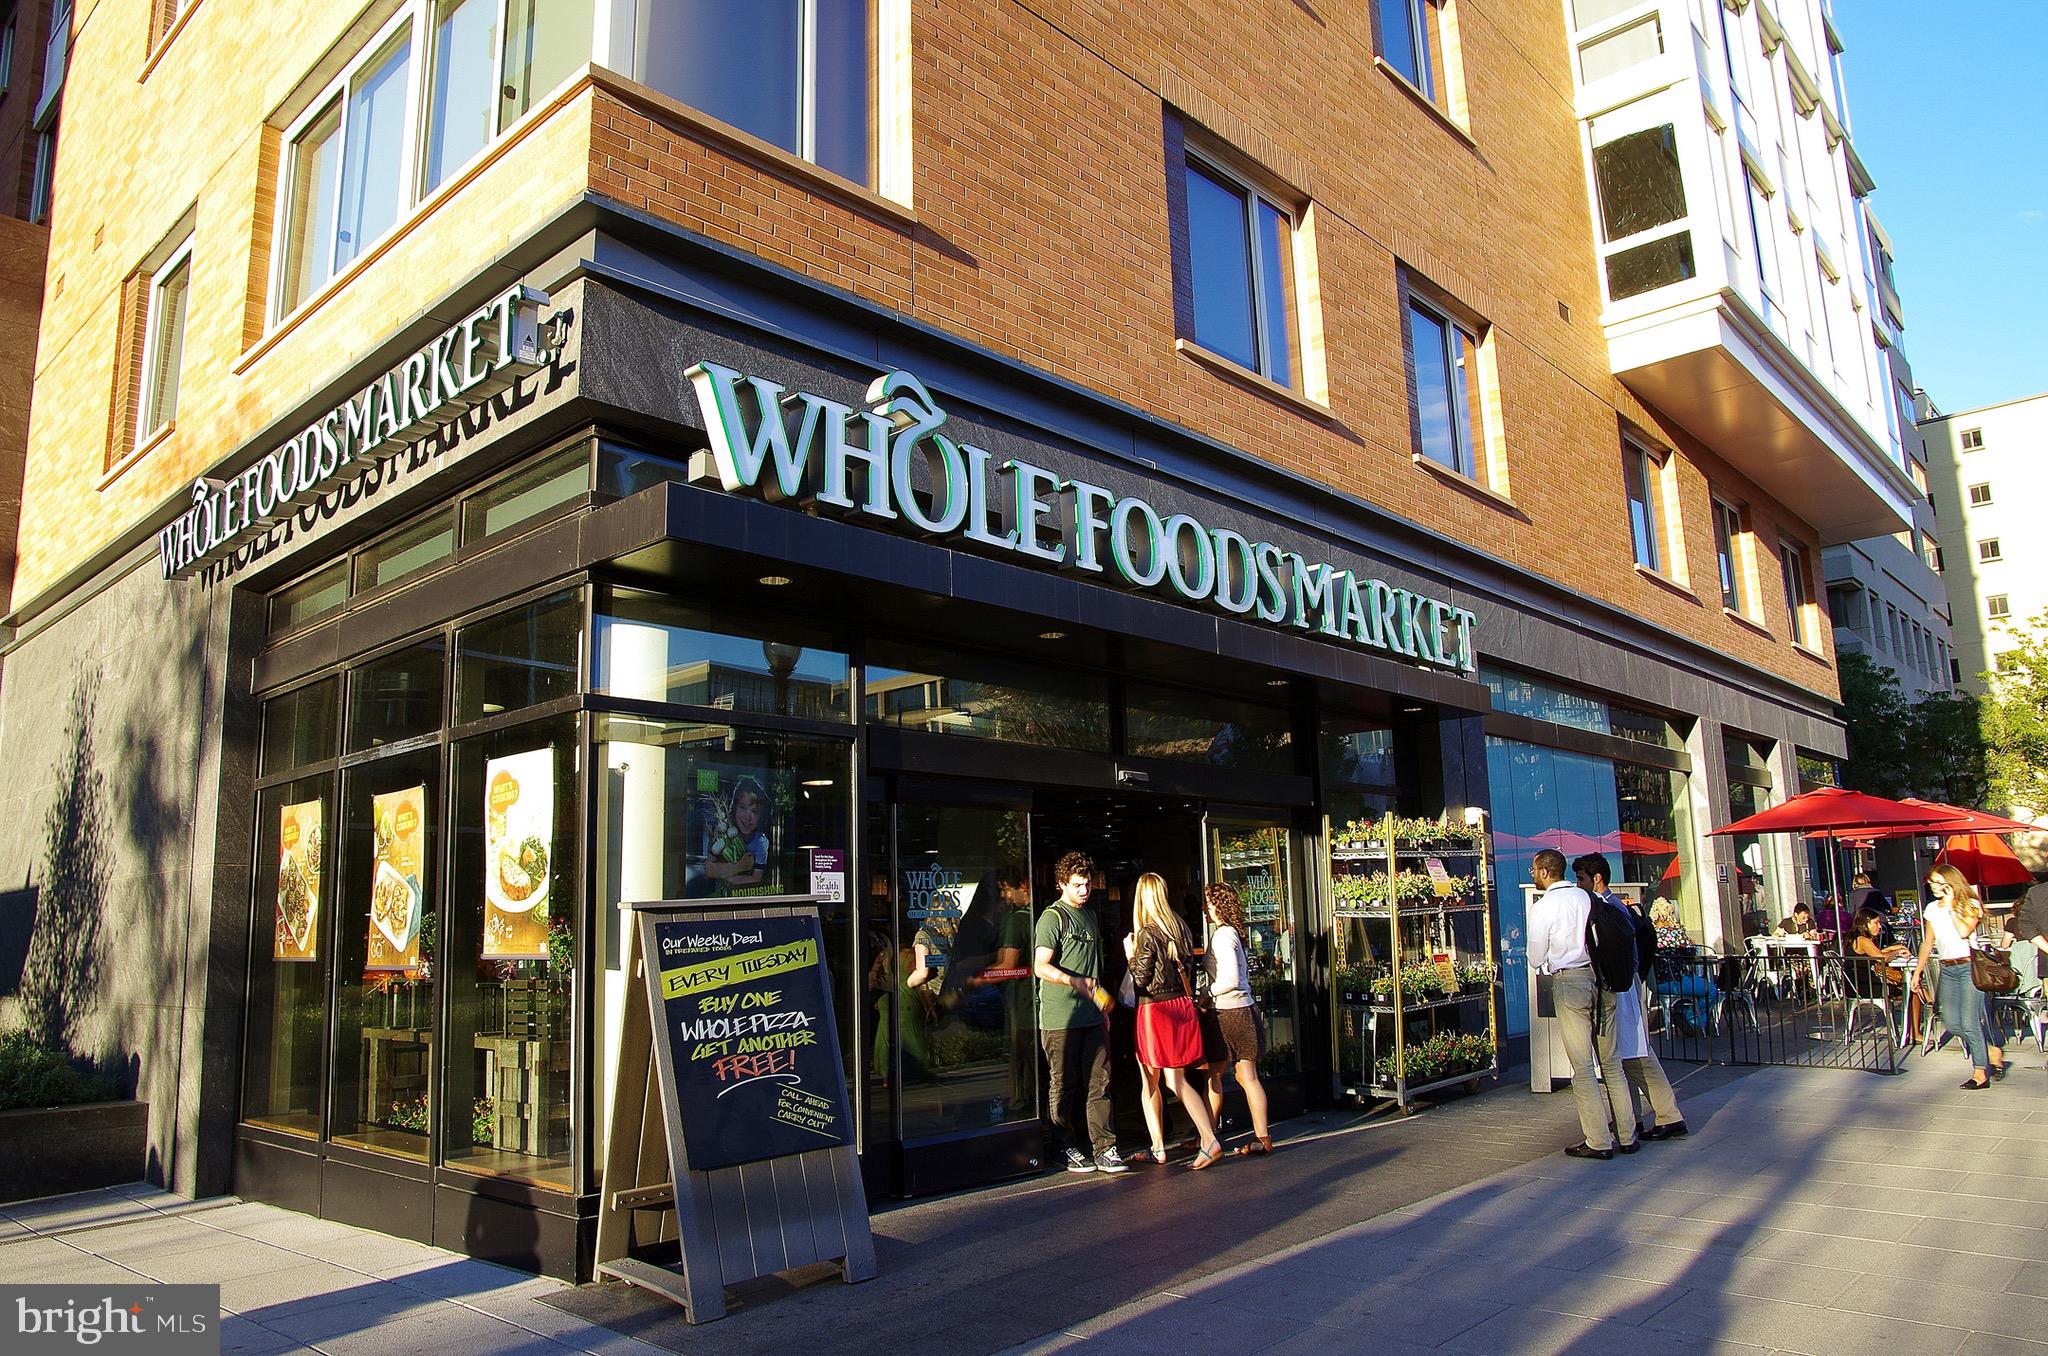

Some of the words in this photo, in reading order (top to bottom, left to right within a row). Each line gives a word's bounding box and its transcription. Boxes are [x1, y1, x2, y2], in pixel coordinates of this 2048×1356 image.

[340, 284, 524, 466] MARKET
[1068, 479, 1288, 624] FOODS
[1284, 552, 1478, 673] MARKET
[905, 863, 963, 890] WHOLE
[731, 884, 785, 897] NOURISHING
[908, 890, 961, 909] FOODS
[662, 936, 687, 950] Our
[687, 933, 730, 948] Weekly
[731, 931, 763, 946] Deal
[669, 965, 730, 992] EVERY
[736, 946, 809, 976] TUESDAY
[698, 993, 740, 1014] BUY
[741, 990, 782, 1009] ONE
[690, 1038, 733, 1061] GET
[737, 1029, 818, 1055] ANOTHER
[711, 1049, 796, 1081] FREE!
[777, 1098, 793, 1110] FOR
[781, 1089, 803, 1101] CALL
[804, 1096, 830, 1110] AHEAD
[777, 1109, 806, 1125] CARRY
[806, 1118, 828, 1130] OUT
